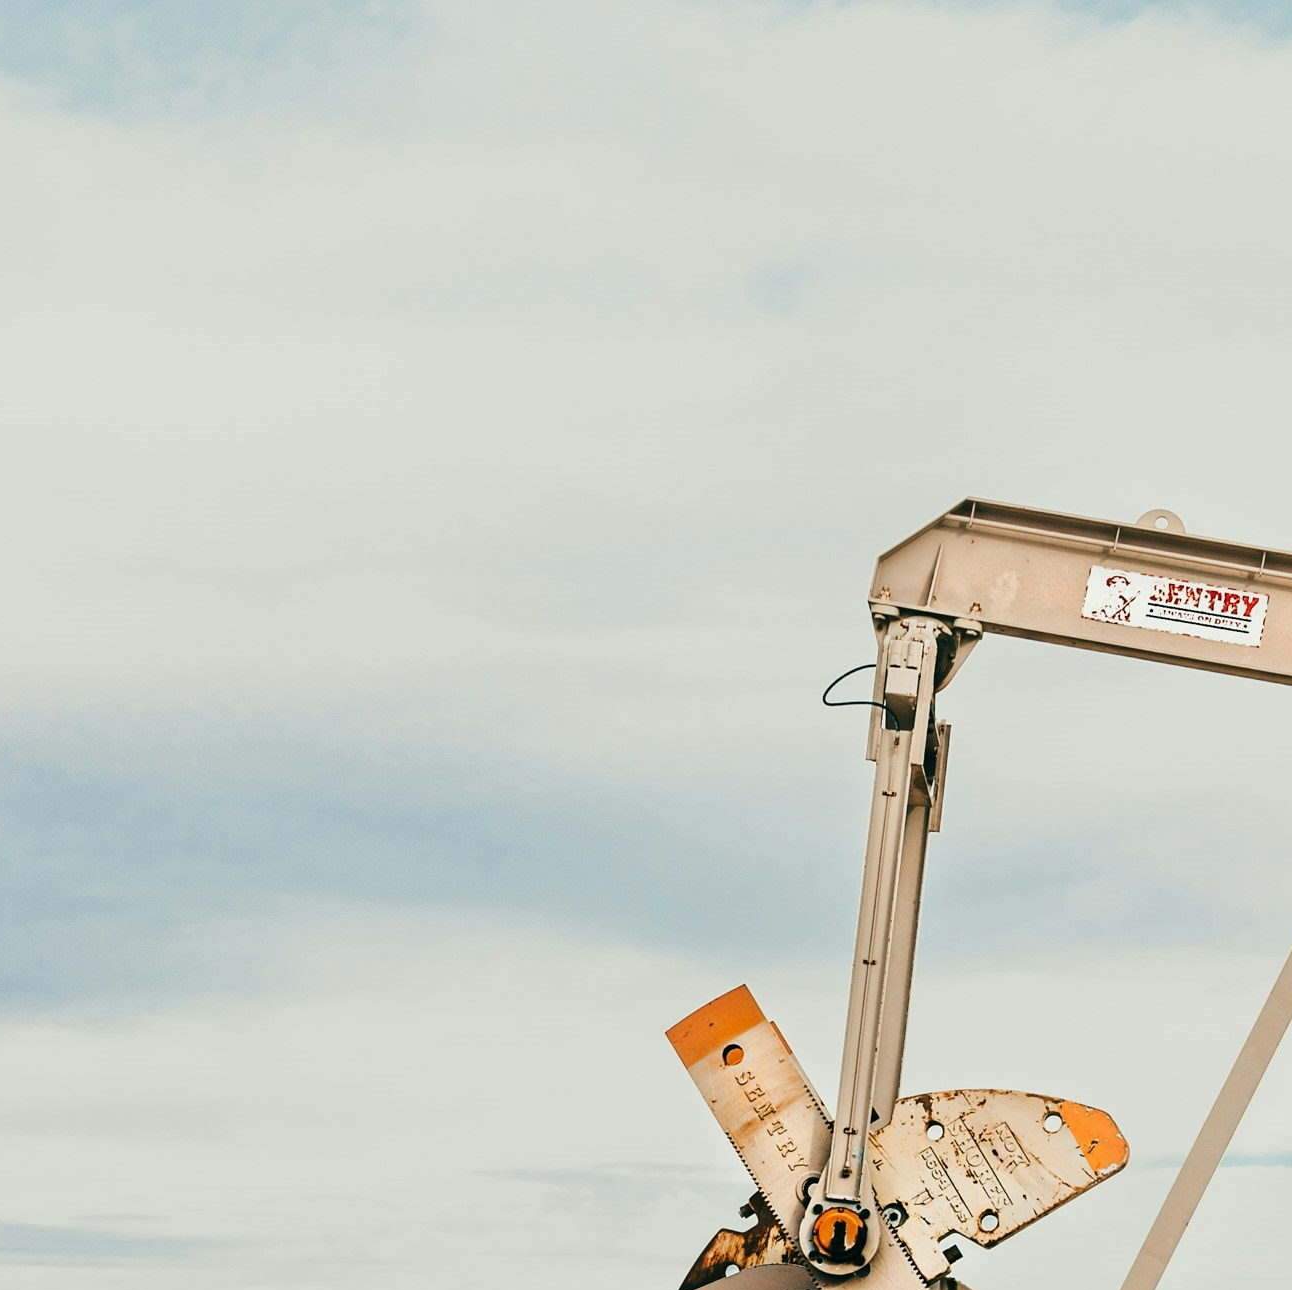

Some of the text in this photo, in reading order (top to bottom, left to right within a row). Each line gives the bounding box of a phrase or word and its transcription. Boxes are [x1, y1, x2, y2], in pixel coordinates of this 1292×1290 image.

[1149, 583, 1260, 617] SENTRY
[734, 1071, 809, 1172] SENTRY
[946, 1117, 1010, 1212] SHORES
